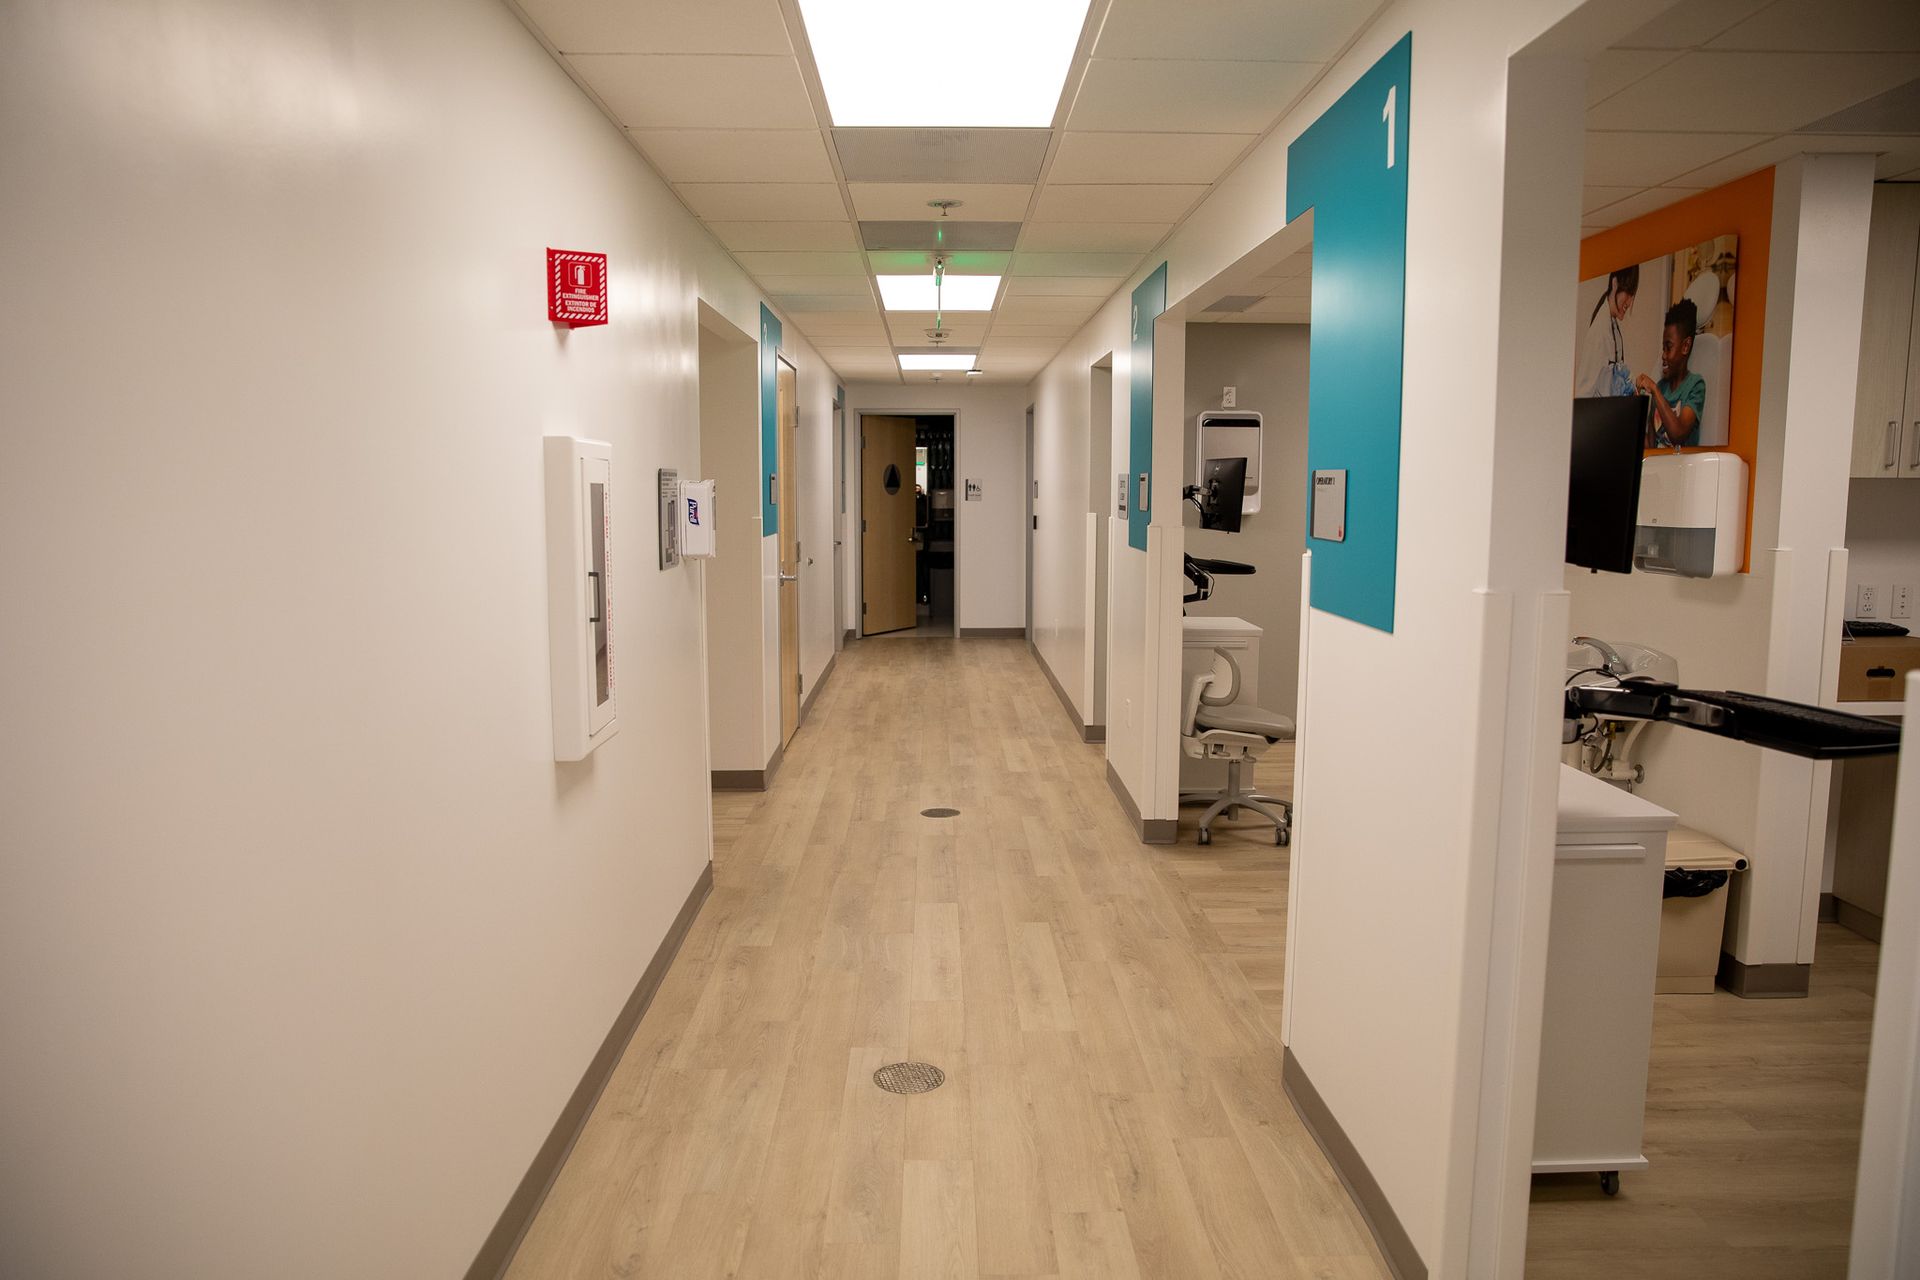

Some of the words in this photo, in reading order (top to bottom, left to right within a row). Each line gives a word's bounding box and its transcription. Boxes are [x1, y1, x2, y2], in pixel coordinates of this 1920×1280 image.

[1382, 85, 1396, 169] 1
[562, 293, 599, 301] EXTINGUISHER
[1133, 304, 1138, 341] 2
